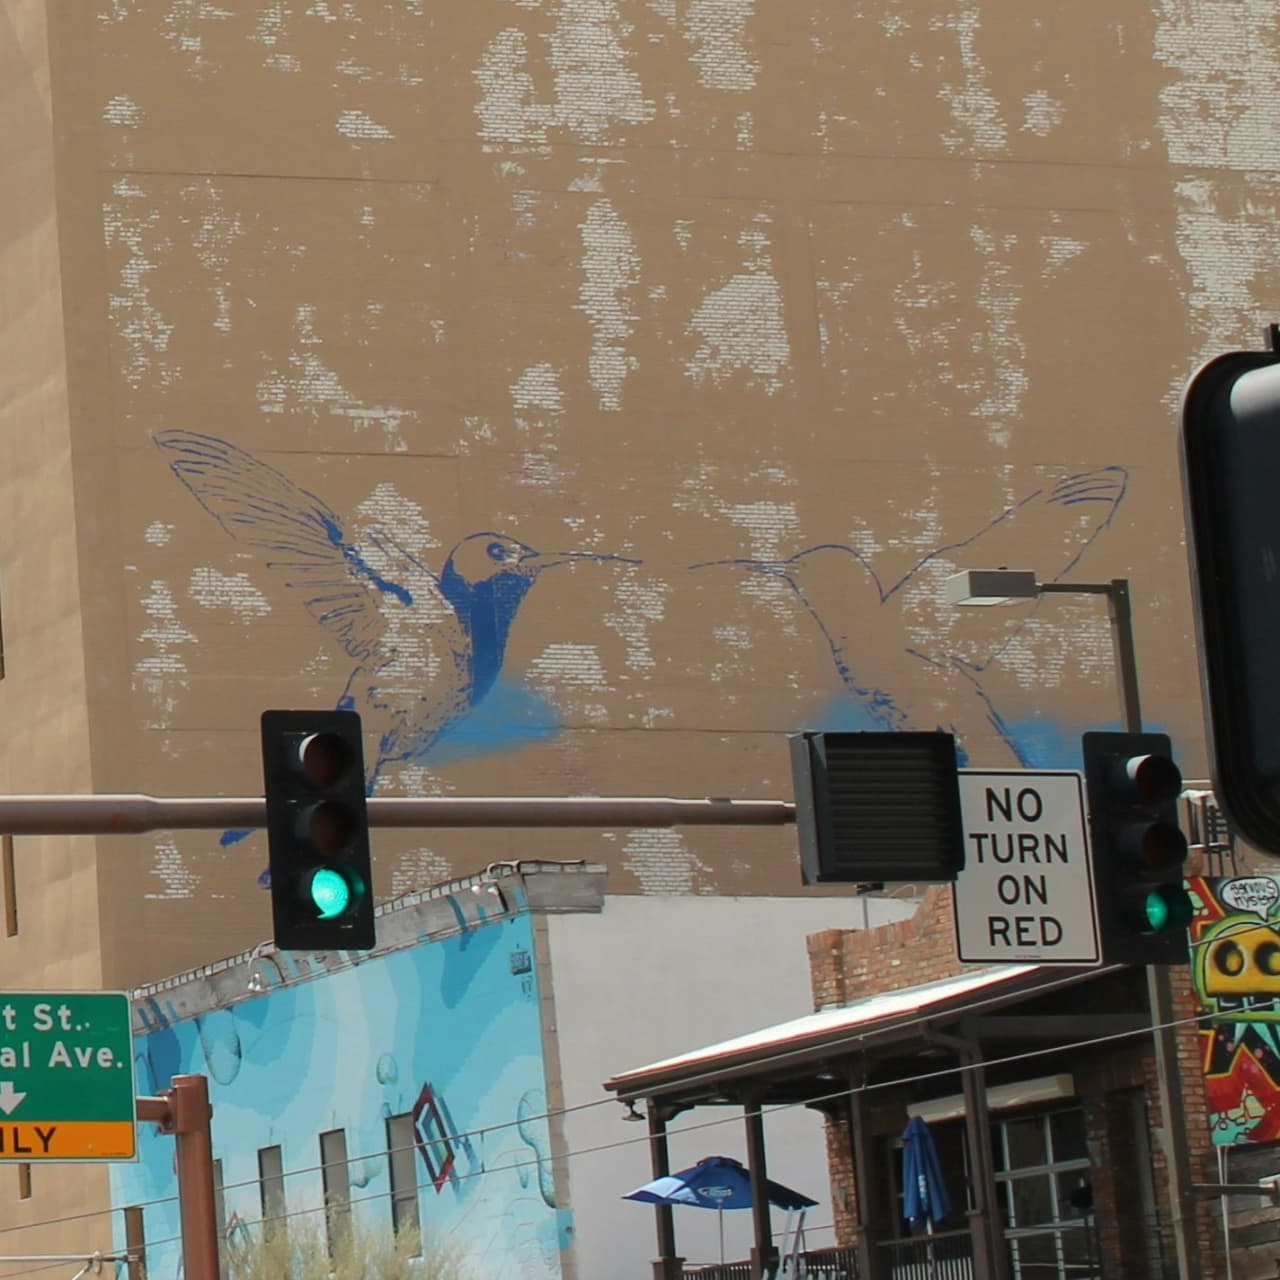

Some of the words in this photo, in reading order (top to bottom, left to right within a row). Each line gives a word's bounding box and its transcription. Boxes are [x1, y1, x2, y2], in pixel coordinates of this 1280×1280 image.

[985, 787, 1043, 822] NO
[969, 833, 1069, 864] TURN
[997, 874, 1048, 906] ON
[987, 916, 1063, 947] RED
[33, 1003, 84, 1032] St.
[48, 1040, 124, 1069] Ave.
